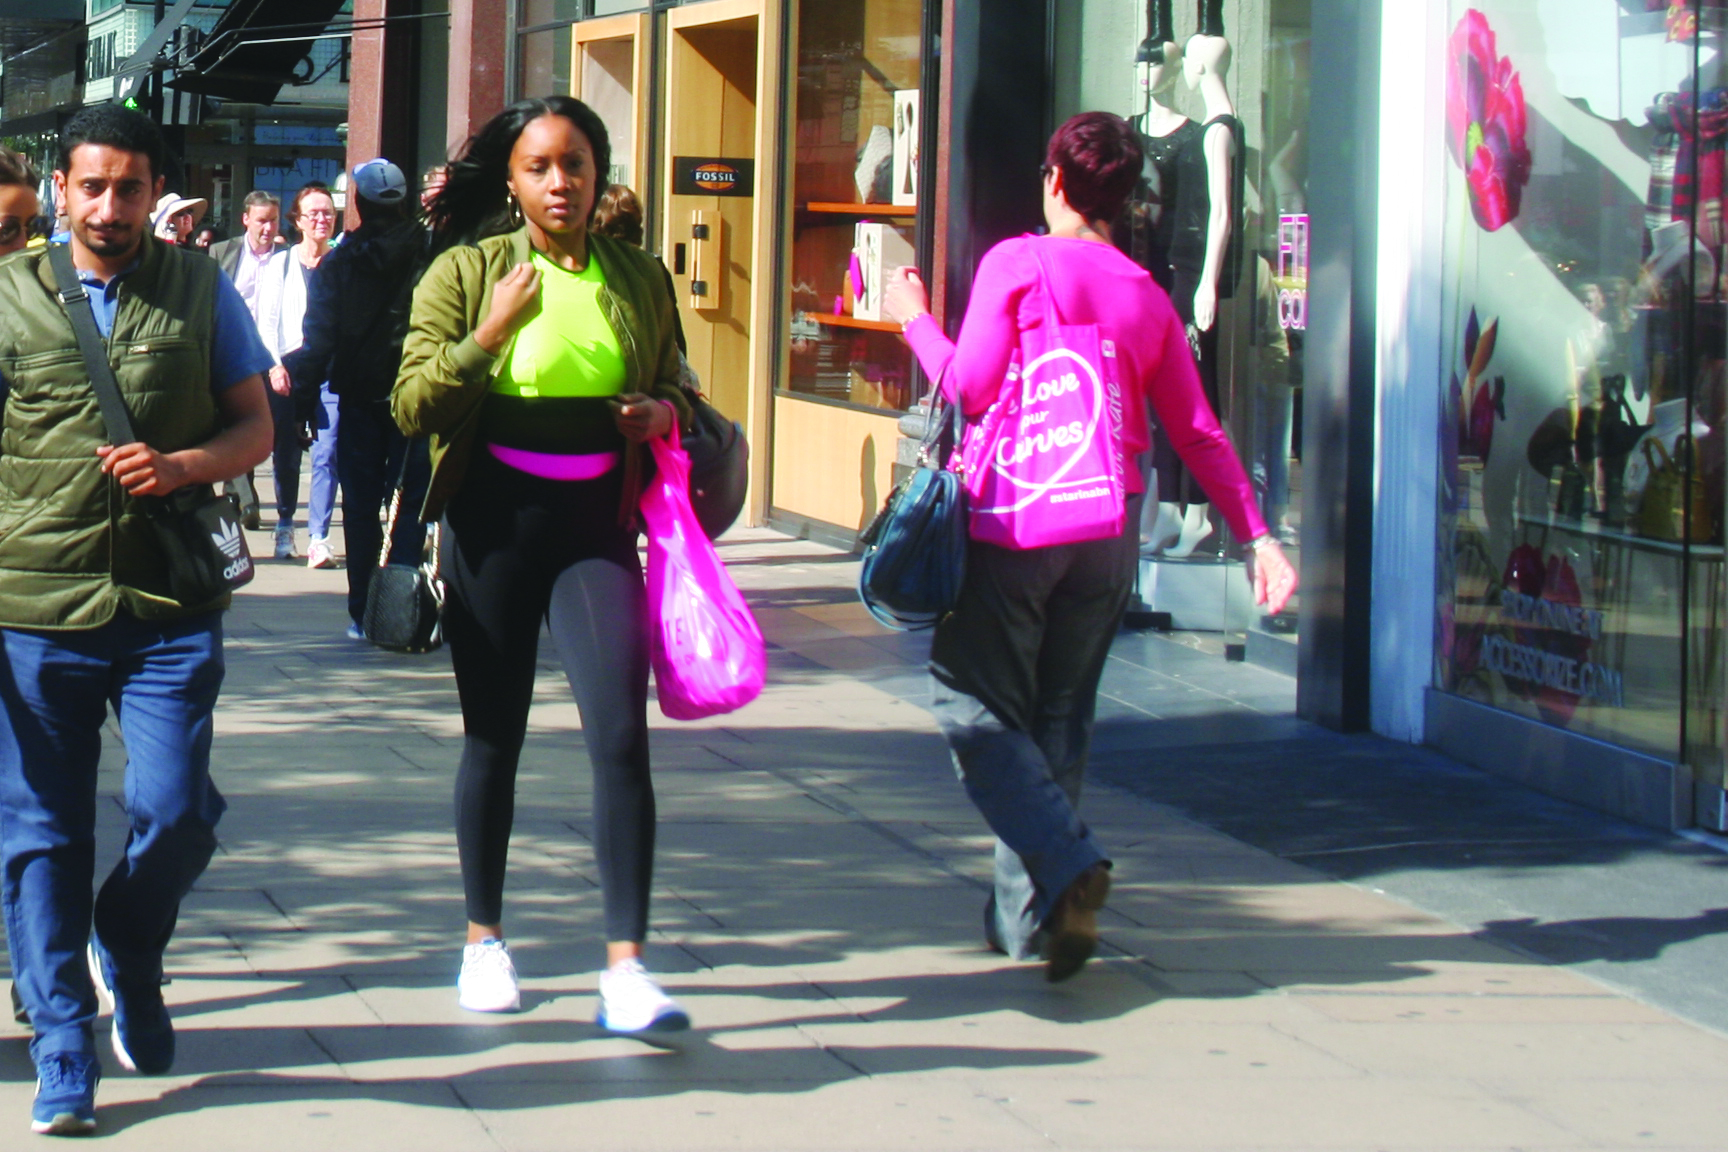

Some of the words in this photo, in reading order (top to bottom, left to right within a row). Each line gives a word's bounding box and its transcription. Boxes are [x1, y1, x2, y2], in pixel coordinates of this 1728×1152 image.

[695, 171, 735, 182] FOSSIL
[1021, 372, 1080, 409] Love
[996, 420, 1085, 467] Curves
[223, 556, 250, 580] adidas
